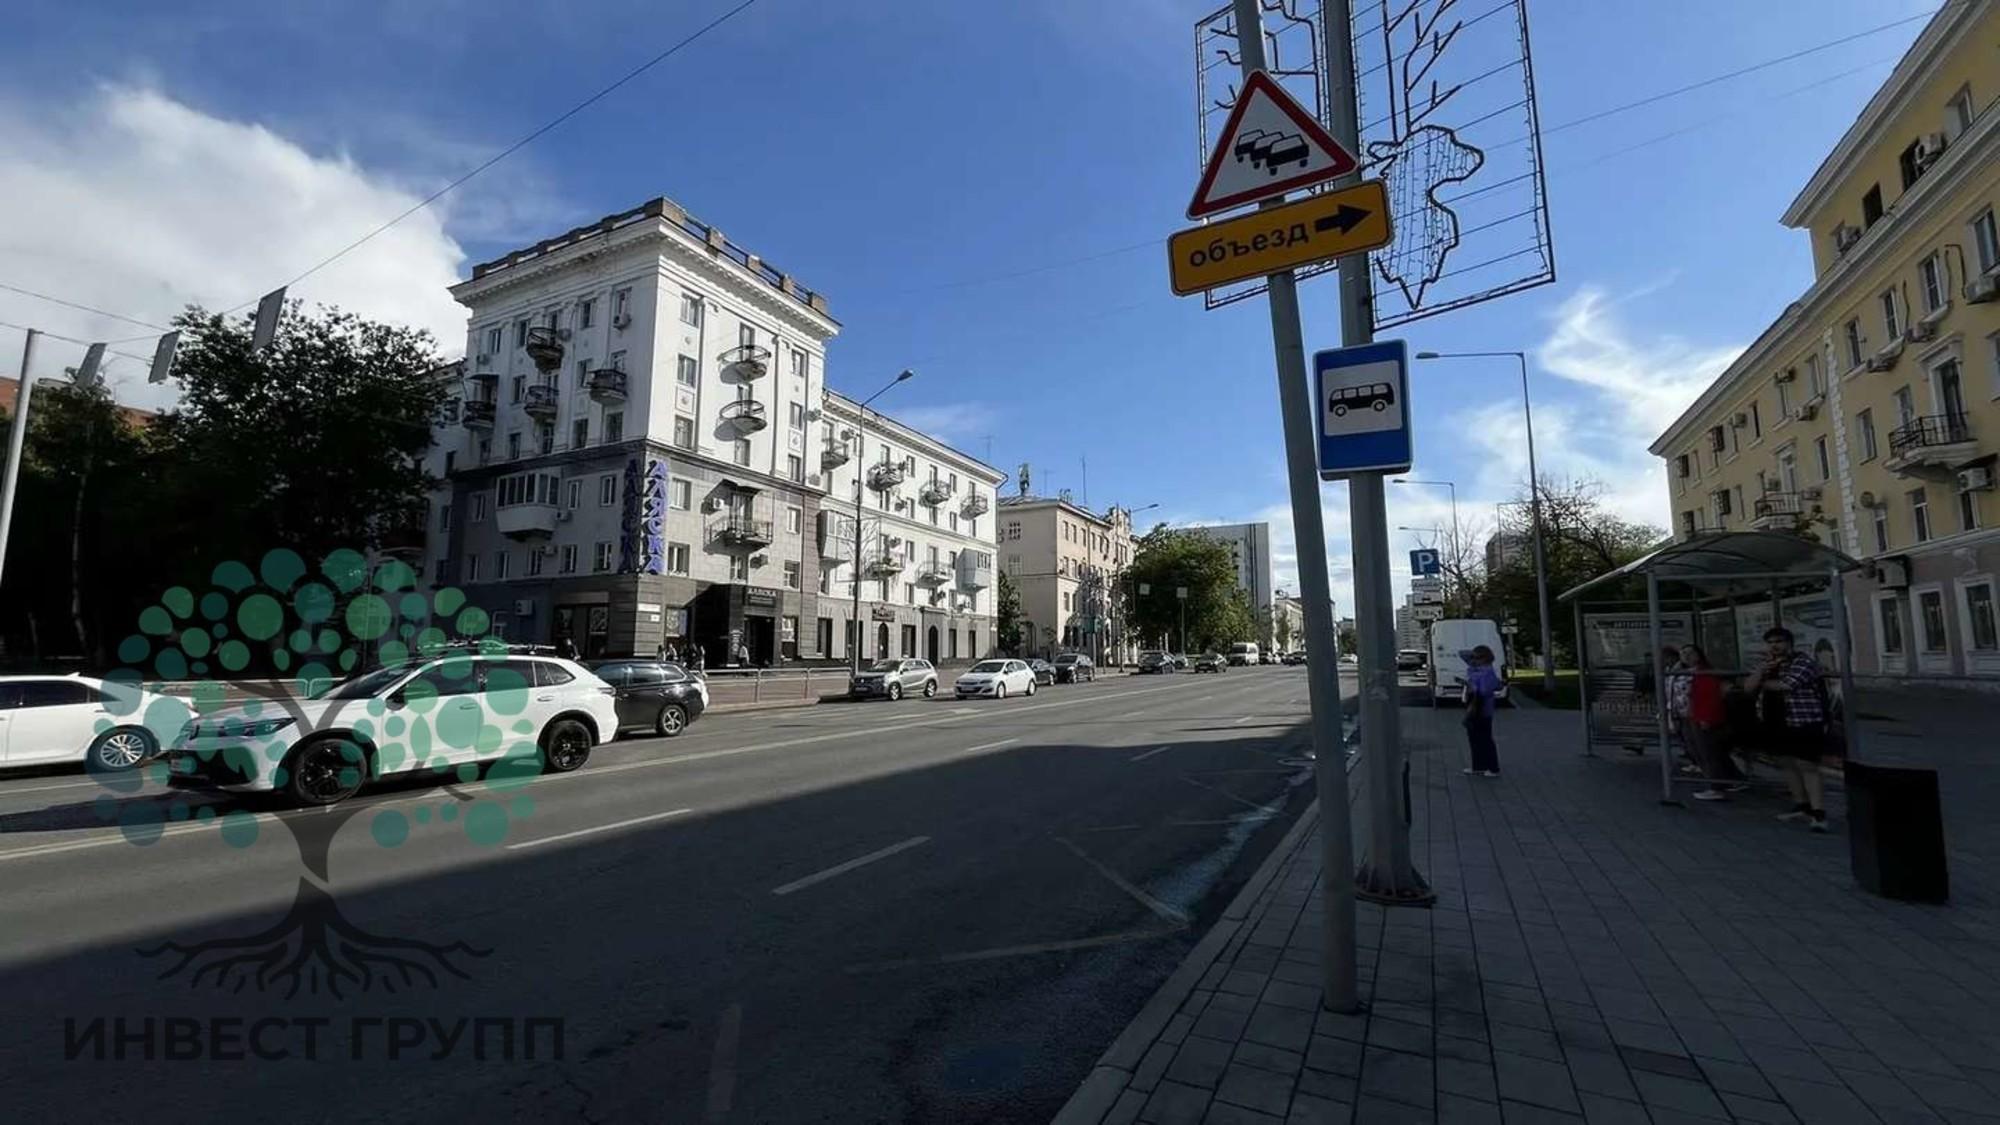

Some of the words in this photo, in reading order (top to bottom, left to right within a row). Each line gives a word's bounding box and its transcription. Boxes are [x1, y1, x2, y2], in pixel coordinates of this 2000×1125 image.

[1190, 223, 1309, 267] объезд
[642, 459, 666, 575] АЛЯСКА
[1418, 552, 1434, 572] P
